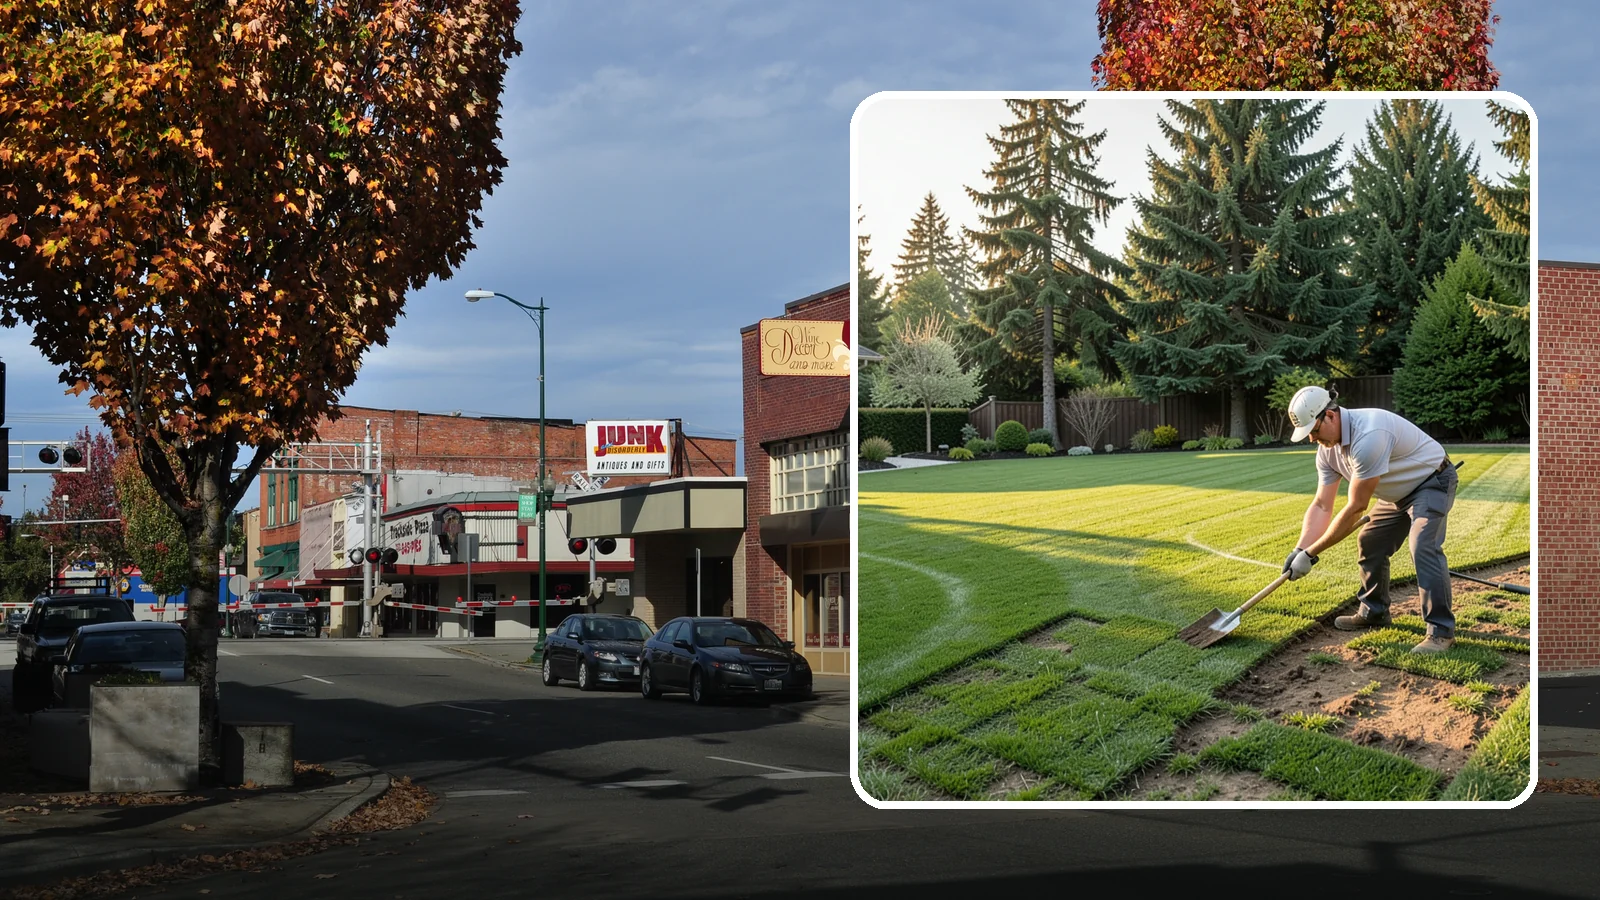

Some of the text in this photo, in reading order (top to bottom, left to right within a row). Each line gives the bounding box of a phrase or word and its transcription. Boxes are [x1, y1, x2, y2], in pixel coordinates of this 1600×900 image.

[595, 425, 664, 457] JUNK
[597, 460, 665, 470] ANTIQUES AND GIFTS
[573, 473, 589, 492] RAIL
[390, 519, 429, 540] Trackside Pizza
